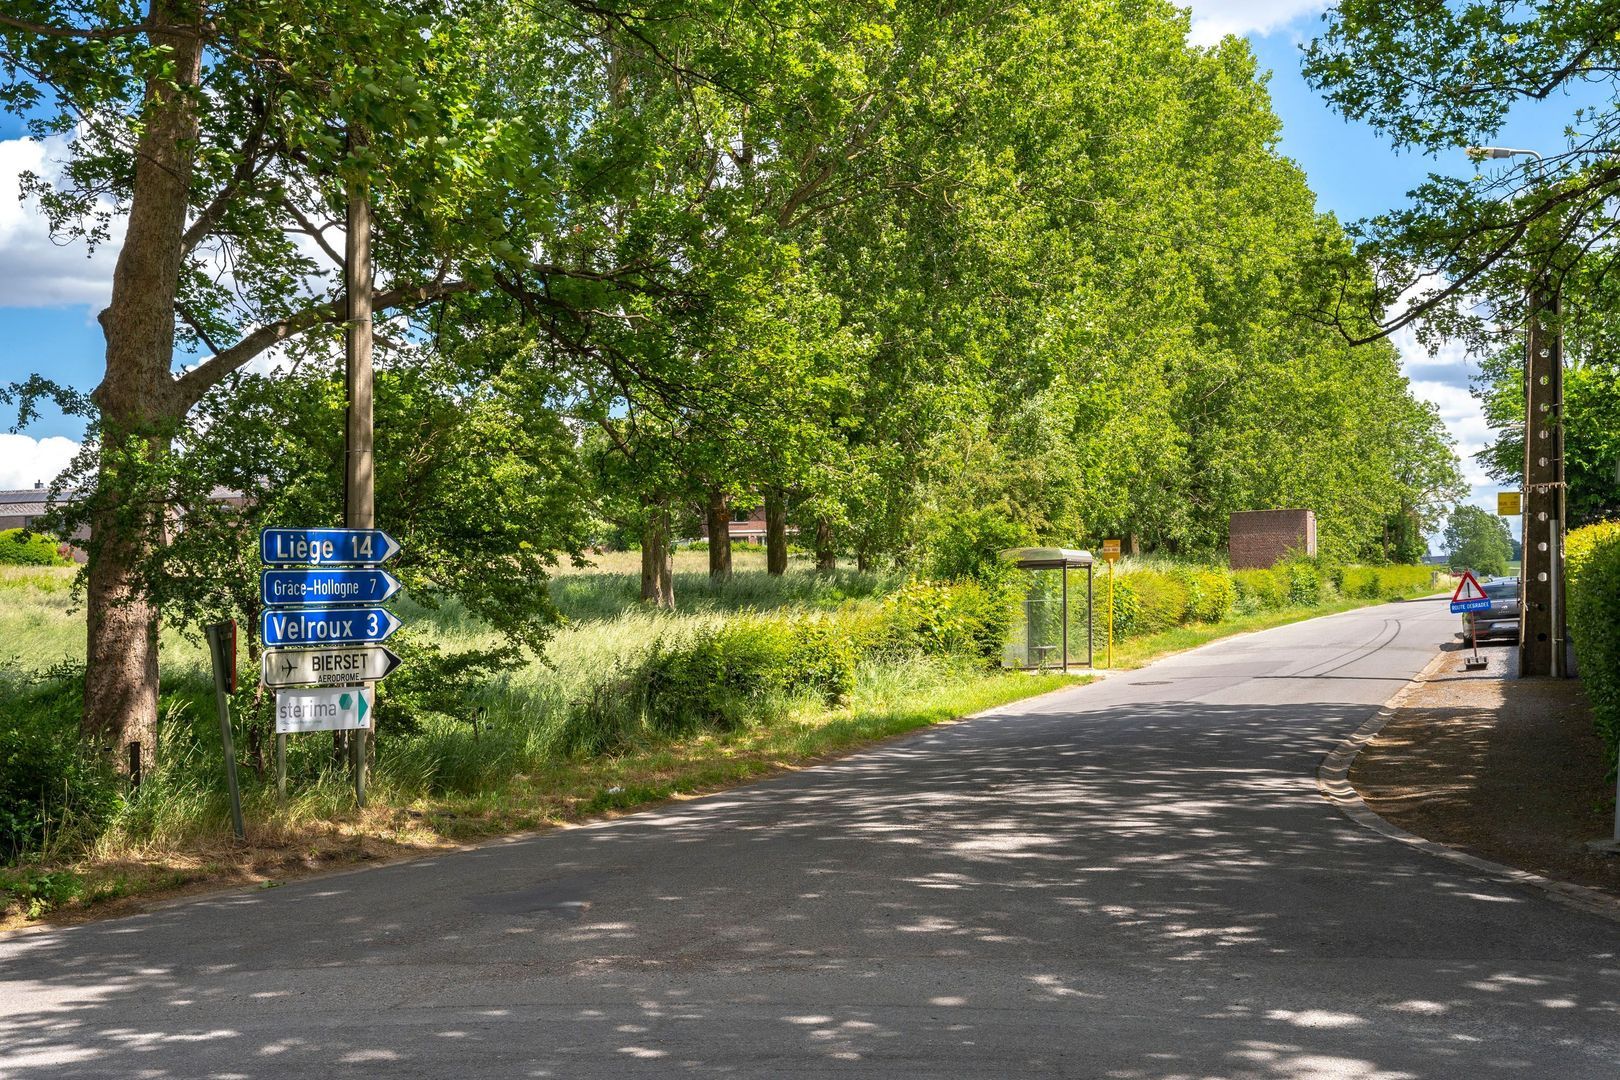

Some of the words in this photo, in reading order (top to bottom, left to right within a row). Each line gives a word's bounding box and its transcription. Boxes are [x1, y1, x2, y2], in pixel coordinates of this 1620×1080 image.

[277, 535, 334, 564] Liège
[351, 535, 373, 558] 14
[274, 579, 359, 598] Grâce-Hollogne
[369, 579, 377, 594] 7
[272, 615, 353, 640] Velroux
[366, 613, 379, 636] 3
[312, 653, 368, 672] BIERSET
[318, 672, 360, 683] AERODROME
[280, 700, 337, 719] sterima
